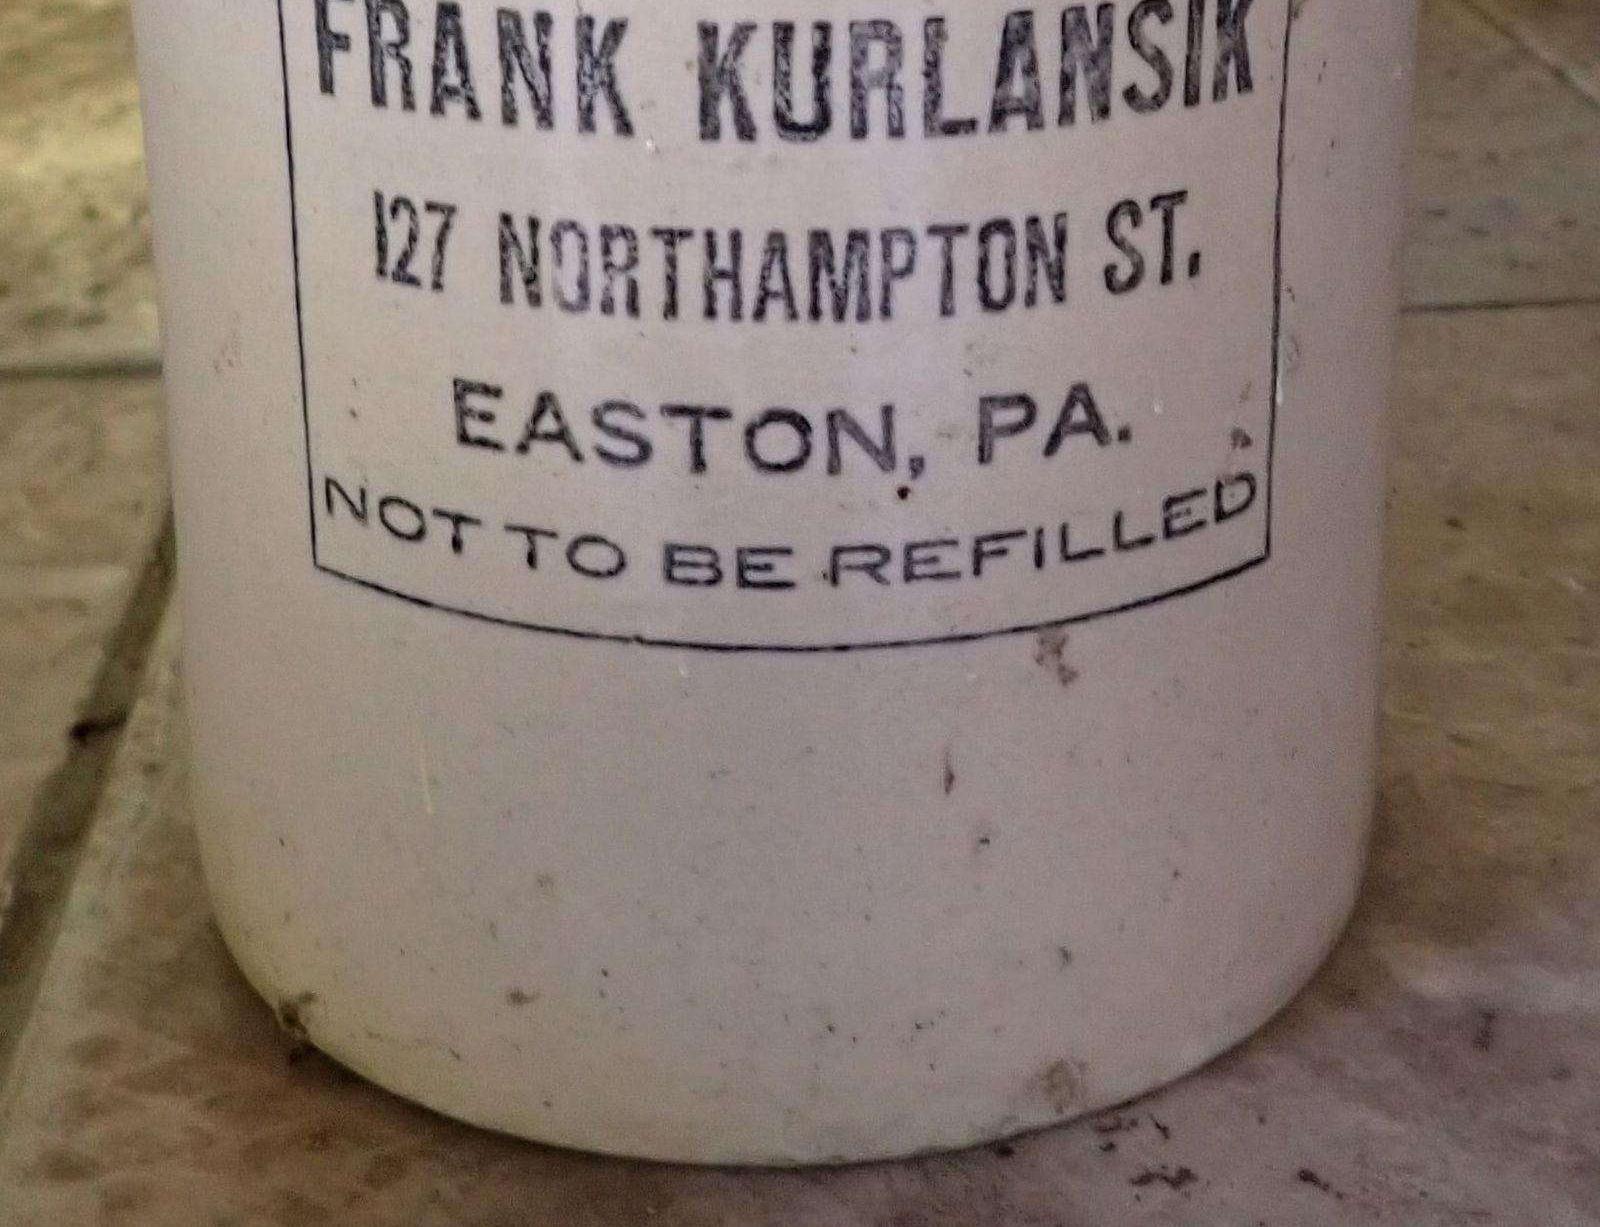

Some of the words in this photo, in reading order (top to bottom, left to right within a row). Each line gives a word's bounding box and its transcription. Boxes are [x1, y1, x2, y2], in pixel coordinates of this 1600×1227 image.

[372, 188, 459, 294] 127
[496, 210, 1069, 325] NORTHAMPTON
[1102, 188, 1203, 297] ST.
[451, 376, 926, 481] EASTON,
[976, 381, 1133, 467] PA.
[323, 475, 483, 556] NOT
[502, 523, 629, 581] TO
[661, 541, 798, 592] BE
[827, 471, 1258, 589] REFILLED
